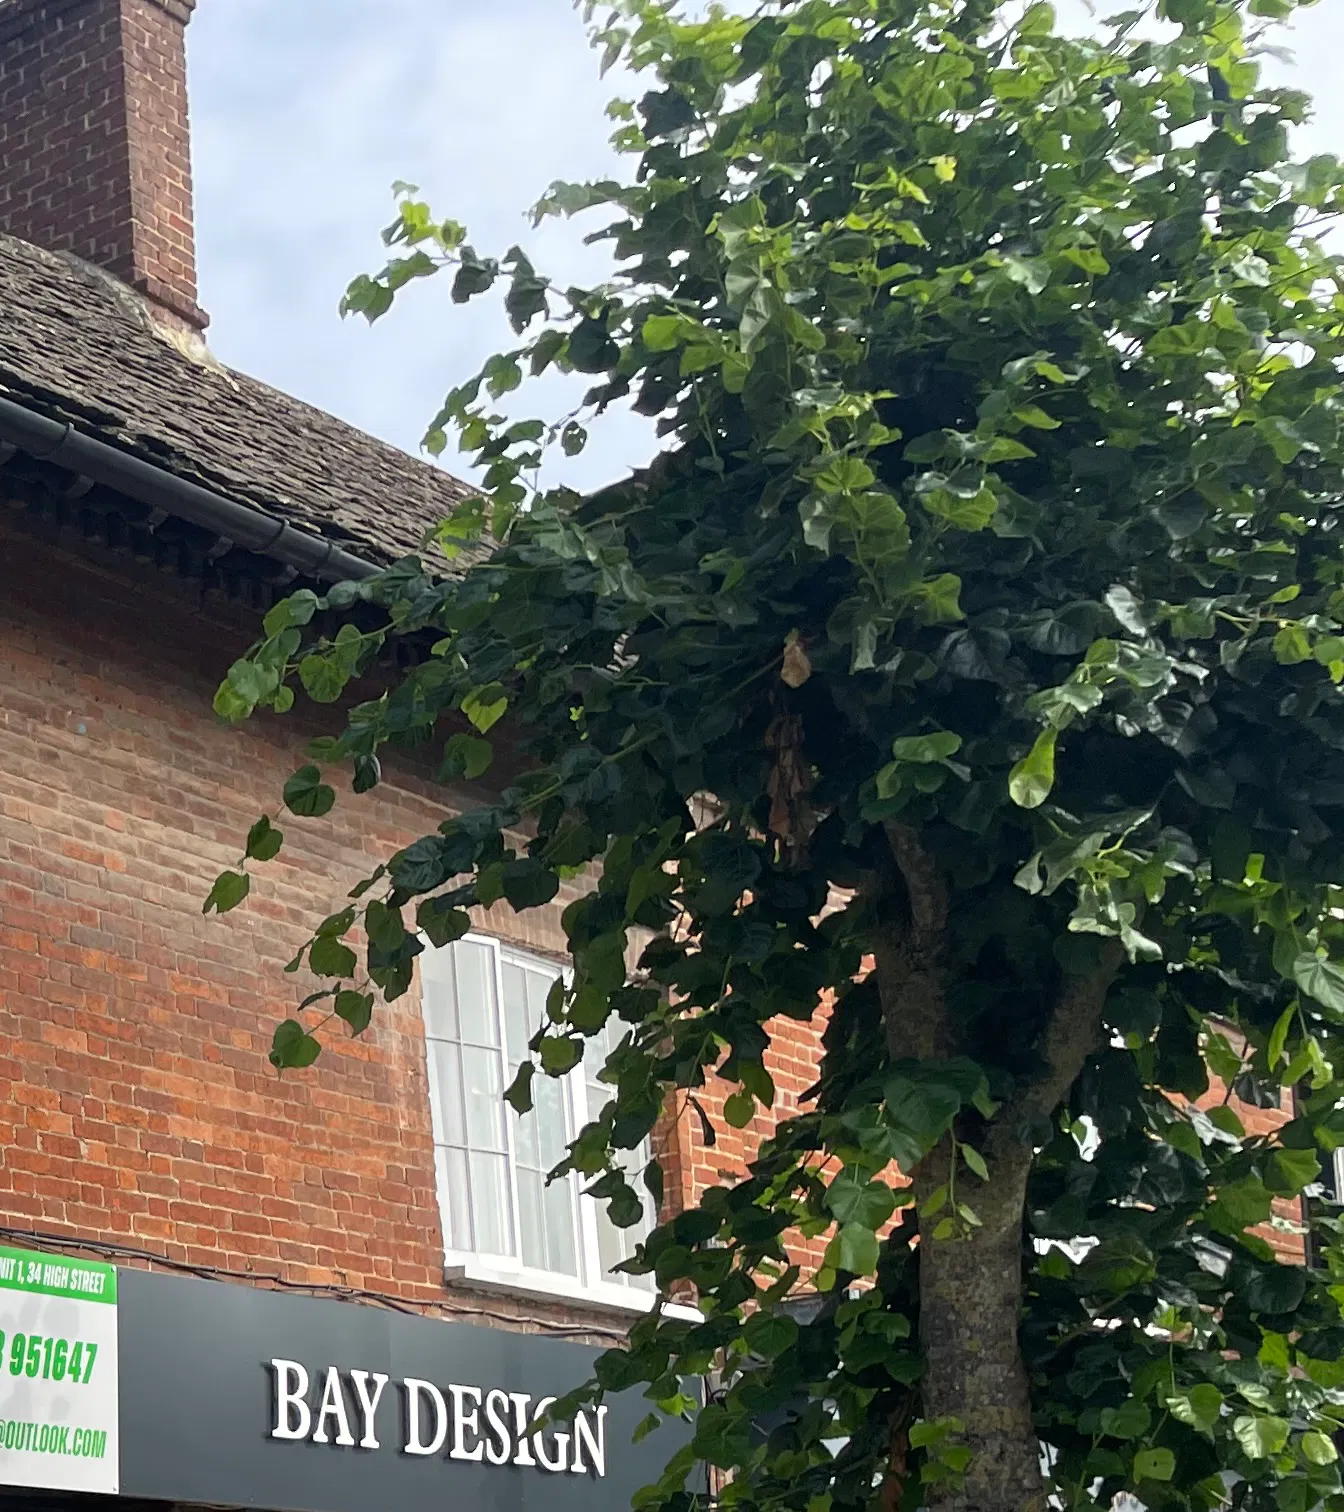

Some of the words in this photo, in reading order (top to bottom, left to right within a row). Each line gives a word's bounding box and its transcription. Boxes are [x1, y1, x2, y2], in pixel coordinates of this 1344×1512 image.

[17, 1260, 25, 1284] 1,
[27, 1261, 42, 1284] 34
[43, 1264, 69, 1289] HIGH
[70, 1268, 106, 1294] STREET
[9, 1332, 98, 1384] 951647
[270, 1358, 389, 1449] BAY
[403, 1377, 608, 1477] DESIGN
